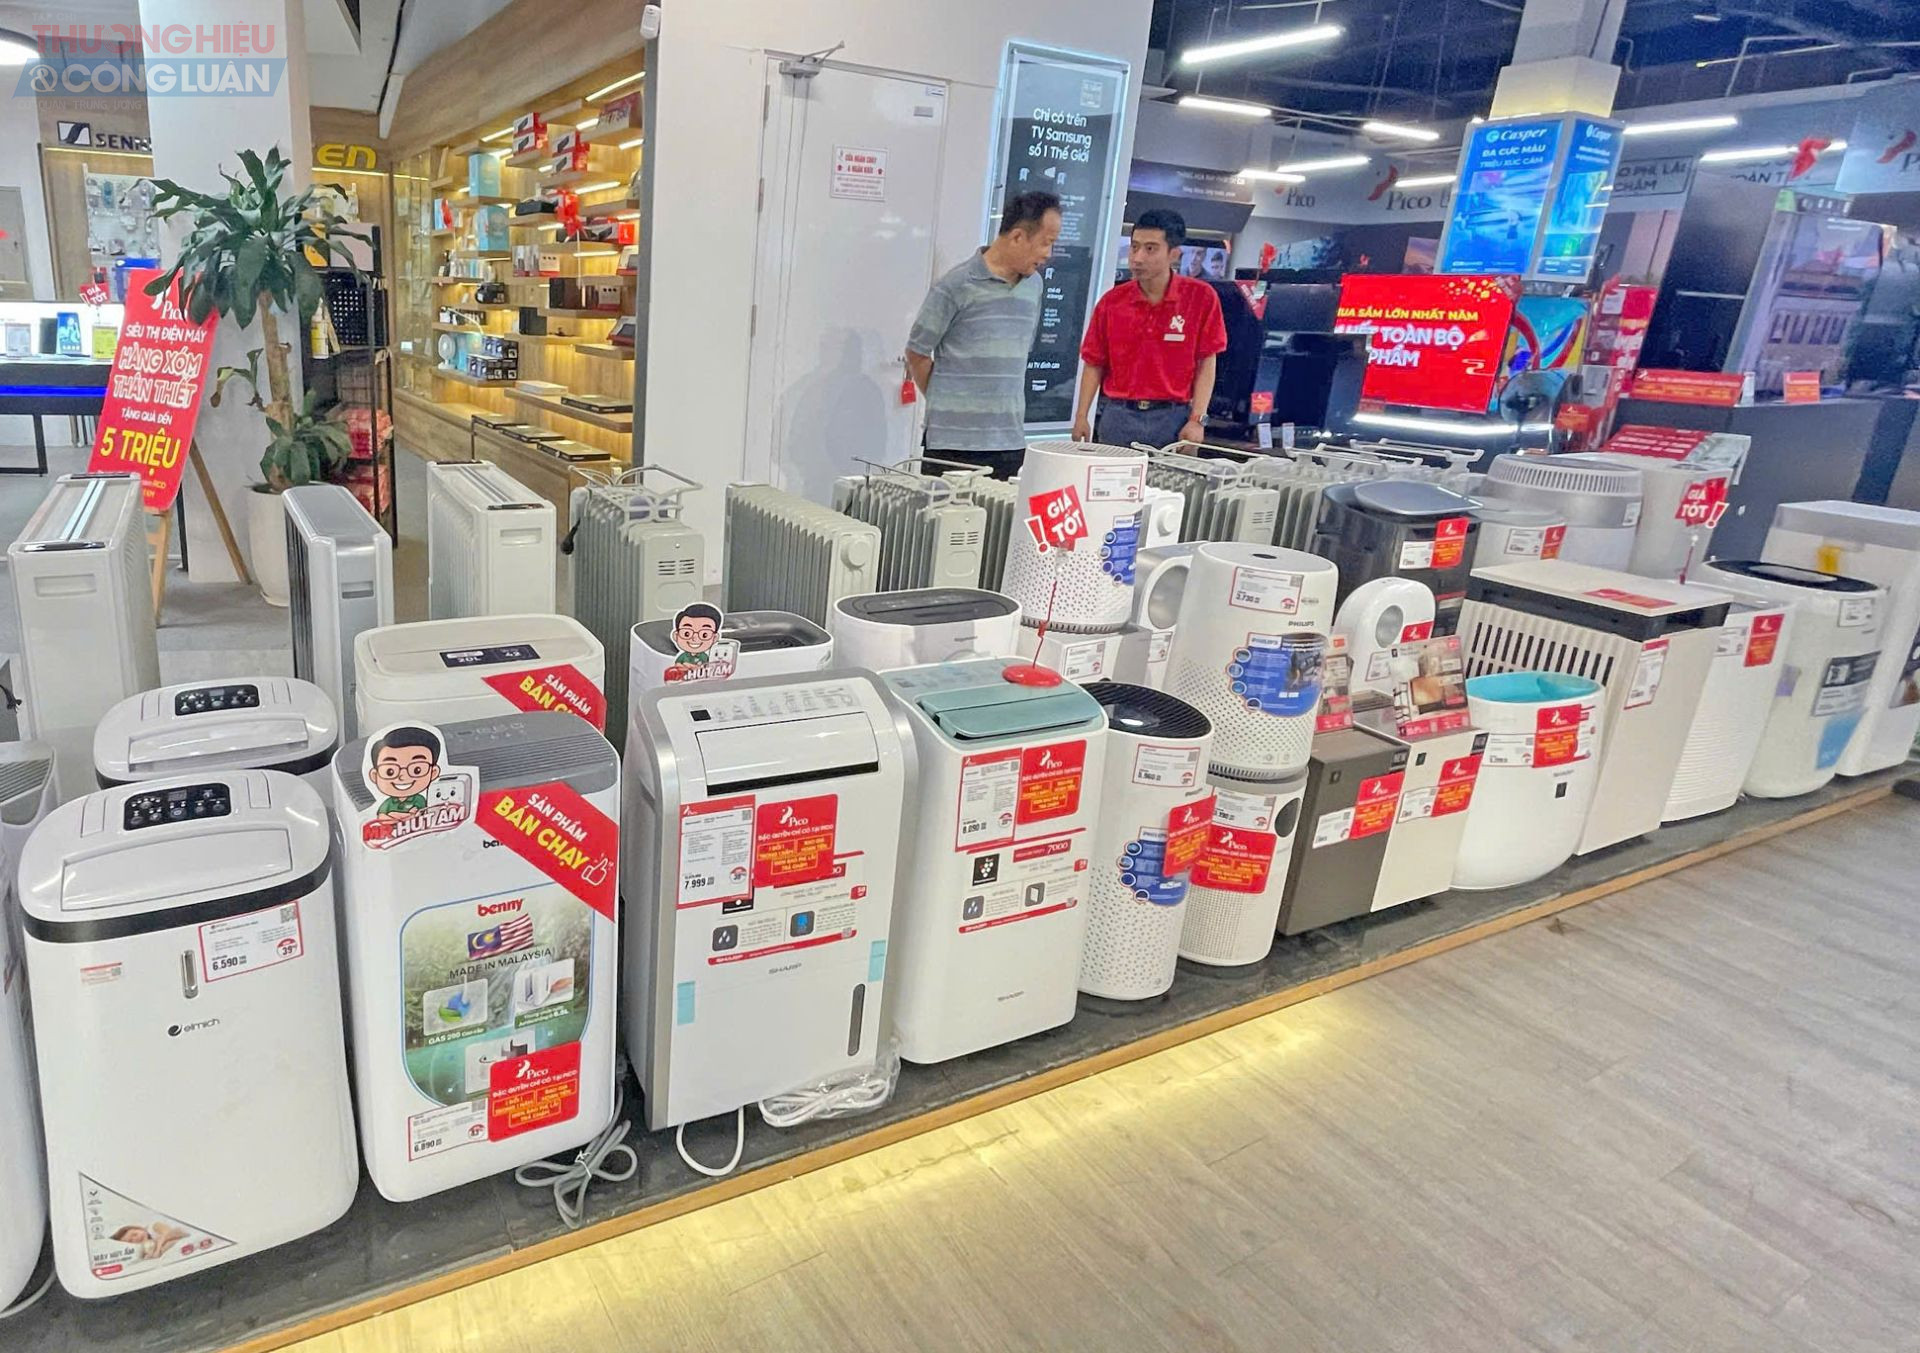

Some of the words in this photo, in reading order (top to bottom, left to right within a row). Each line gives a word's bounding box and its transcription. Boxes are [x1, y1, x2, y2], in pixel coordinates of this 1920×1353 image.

[1033, 107, 1051, 122] Chỉ
[1051, 110, 1065, 124] có
[1066, 112, 1087, 128] trên
[1031, 125, 1045, 139] TV
[1046, 127, 1092, 149] Samsung
[1500, 127, 1548, 142] Casper
[1028, 141, 1043, 157] số
[1050, 144, 1070, 160] Thế
[1070, 148, 1090, 163] Giới
[1286, 186, 1316, 208] Pico
[1385, 191, 1432, 211] Pico
[1357, 305, 1383, 319] SẮM
[1385, 306, 1409, 320] LỚN
[1411, 307, 1446, 321] NHẤT
[1448, 308, 1478, 322] NĂM
[125, 322, 145, 340] SIÊU
[146, 325, 161, 343] THỊ
[161, 324, 185, 345] ĐIỆN
[185, 327, 208, 344] MÁY
[1379, 323, 1432, 346] TOÀN
[1433, 324, 1466, 351] BỘ
[118, 342, 162, 375] HÀNG
[162, 346, 203, 380] XÓM
[1366, 344, 1421, 368] PHẨM
[113, 374, 154, 403] THÂN
[153, 376, 198, 410] THIẾT
[121, 407, 141, 422] TẶNG
[140, 411, 157, 424] QUÀ
[156, 409, 173, 426] ĐẾN
[100, 427, 117, 458] 5
[121, 428, 182, 477] TRIỆU
[1046, 491, 1074, 519] GIÁ
[519, 674, 556, 709] BÁN
[527, 792, 554, 818] SẢN
[552, 809, 588, 843] PHẨM
[788, 816, 809, 828] Pico
[494, 795, 541, 837] BÁN
[536, 826, 590, 870] CHẠY
[684, 878, 706, 889] 7.999
[477, 898, 524, 918] benny
[212, 956, 239, 971] 6.590
[449, 965, 483, 979] MADE
[484, 961, 496, 970] IN
[498, 947, 552, 967] MALAYSIA
[183, 1017, 221, 1034] elmich
